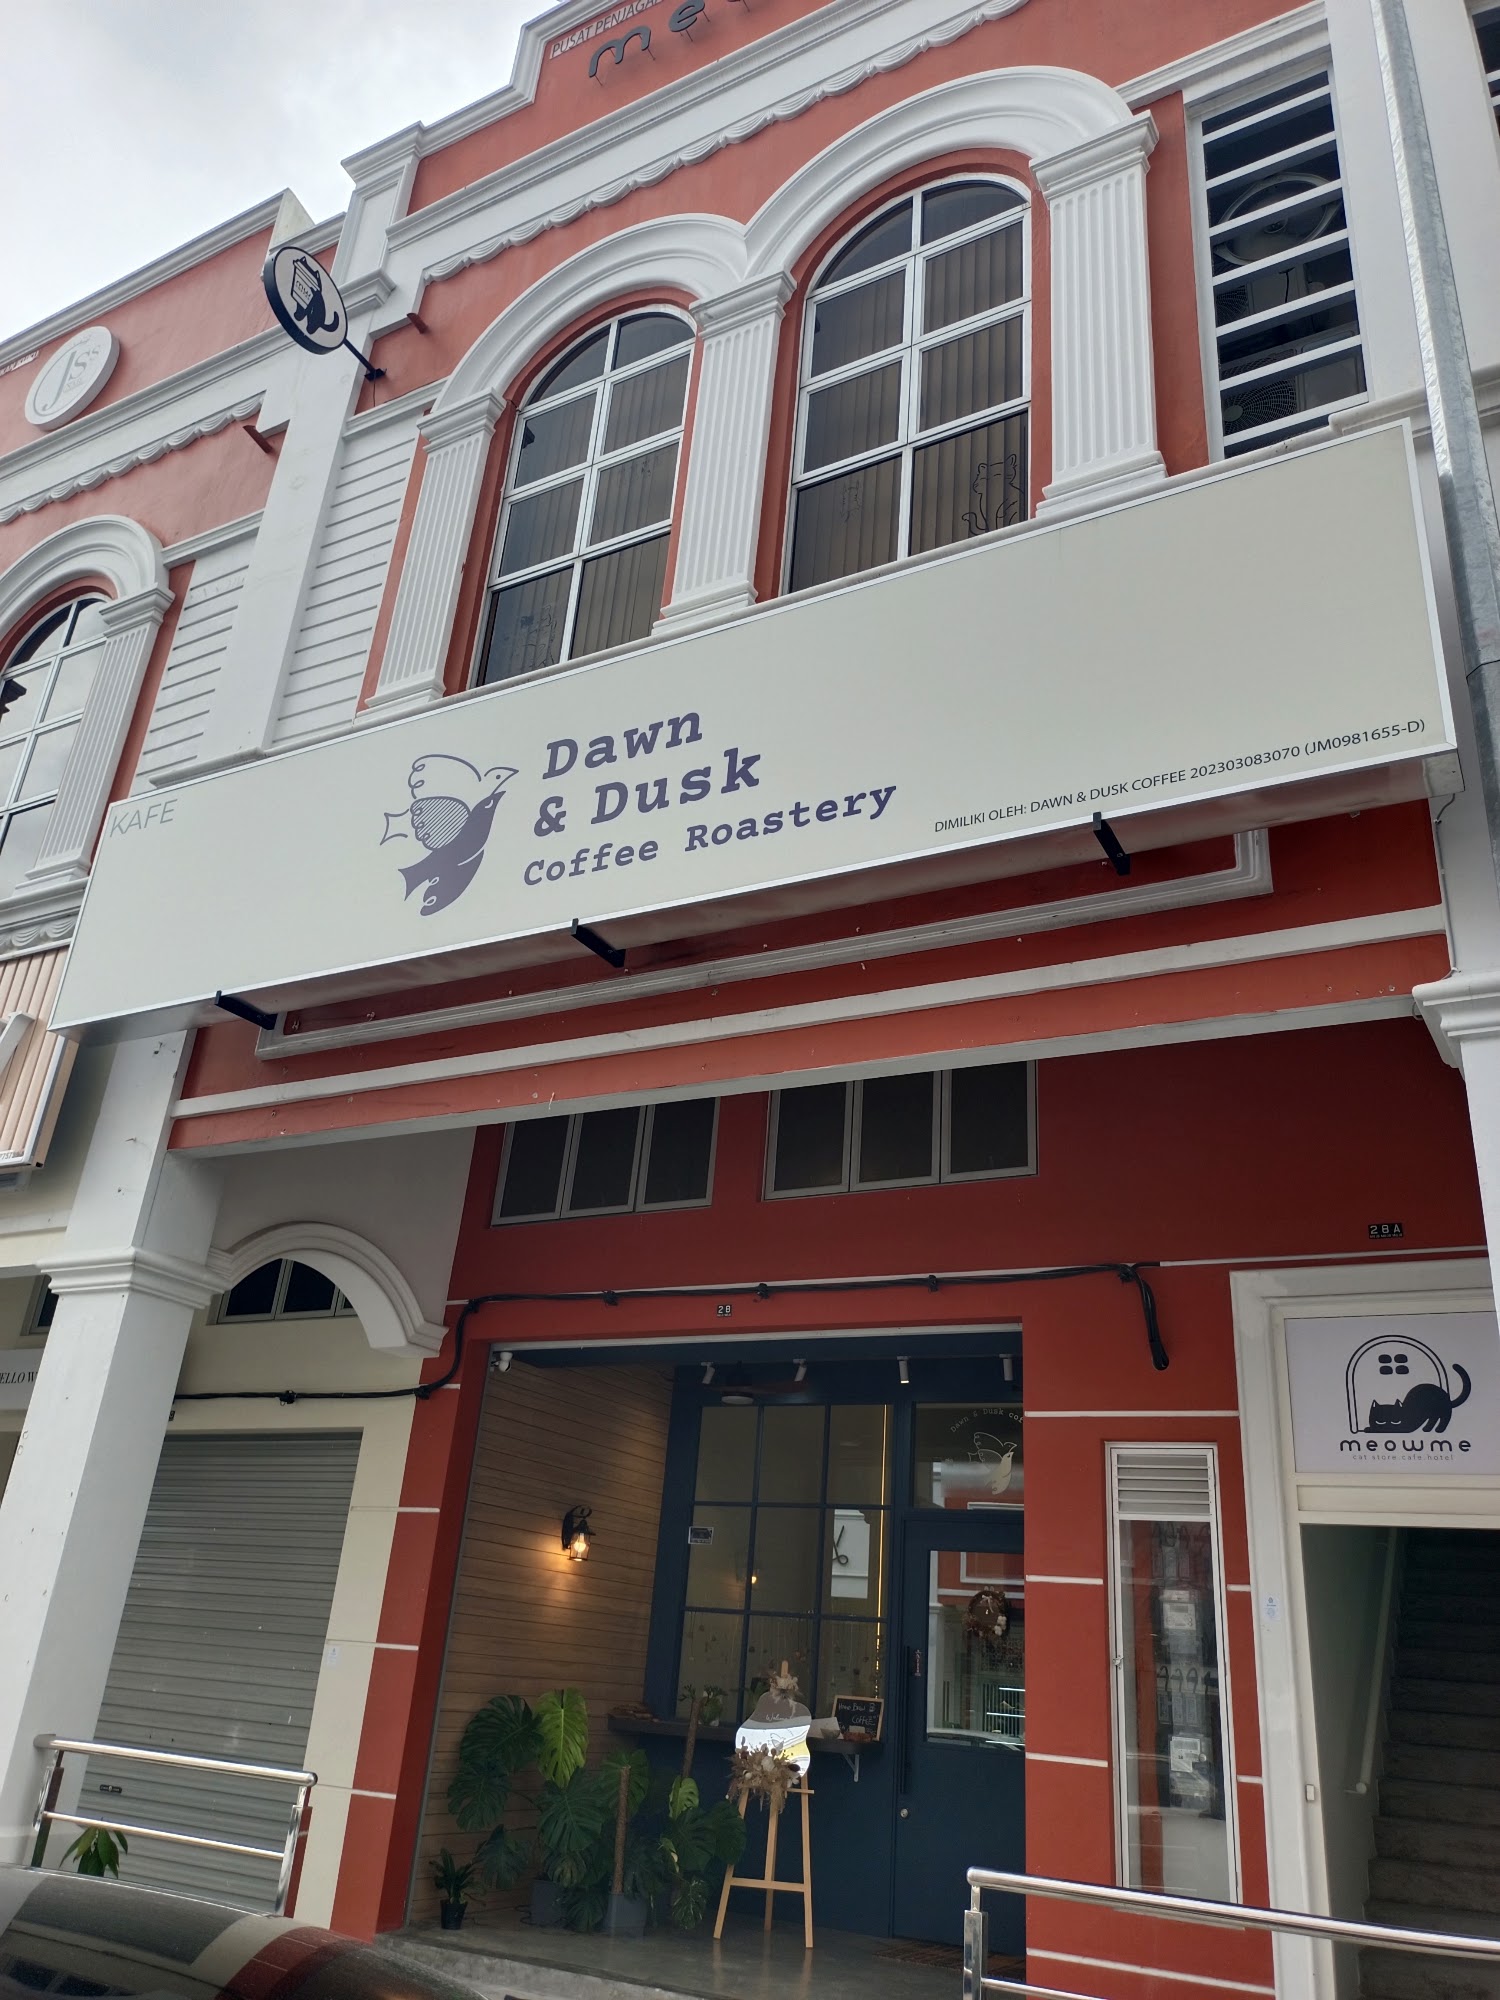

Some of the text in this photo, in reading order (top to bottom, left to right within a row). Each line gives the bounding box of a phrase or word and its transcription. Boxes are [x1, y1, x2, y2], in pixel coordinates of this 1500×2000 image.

[552, 25, 595, 57] PUSAT
[588, 0, 741, 78] me
[542, 711, 703, 780] Dawn
[533, 747, 761, 837] & Dusk
[934, 719, 1425, 833] DIMILIKI OLEH: DAWN & DUSK COFFEE 202303083070 (JM0981655-D)
[110, 799, 178, 838] KAFE
[523, 785, 897, 886] Coffee Roastery
[1370, 1223, 1401, 1235] 28A
[982, 1407, 1004, 1416] Dusk
[1340, 1439, 1471, 1452] meowme
[1352, 1453, 1368, 1461] cat
